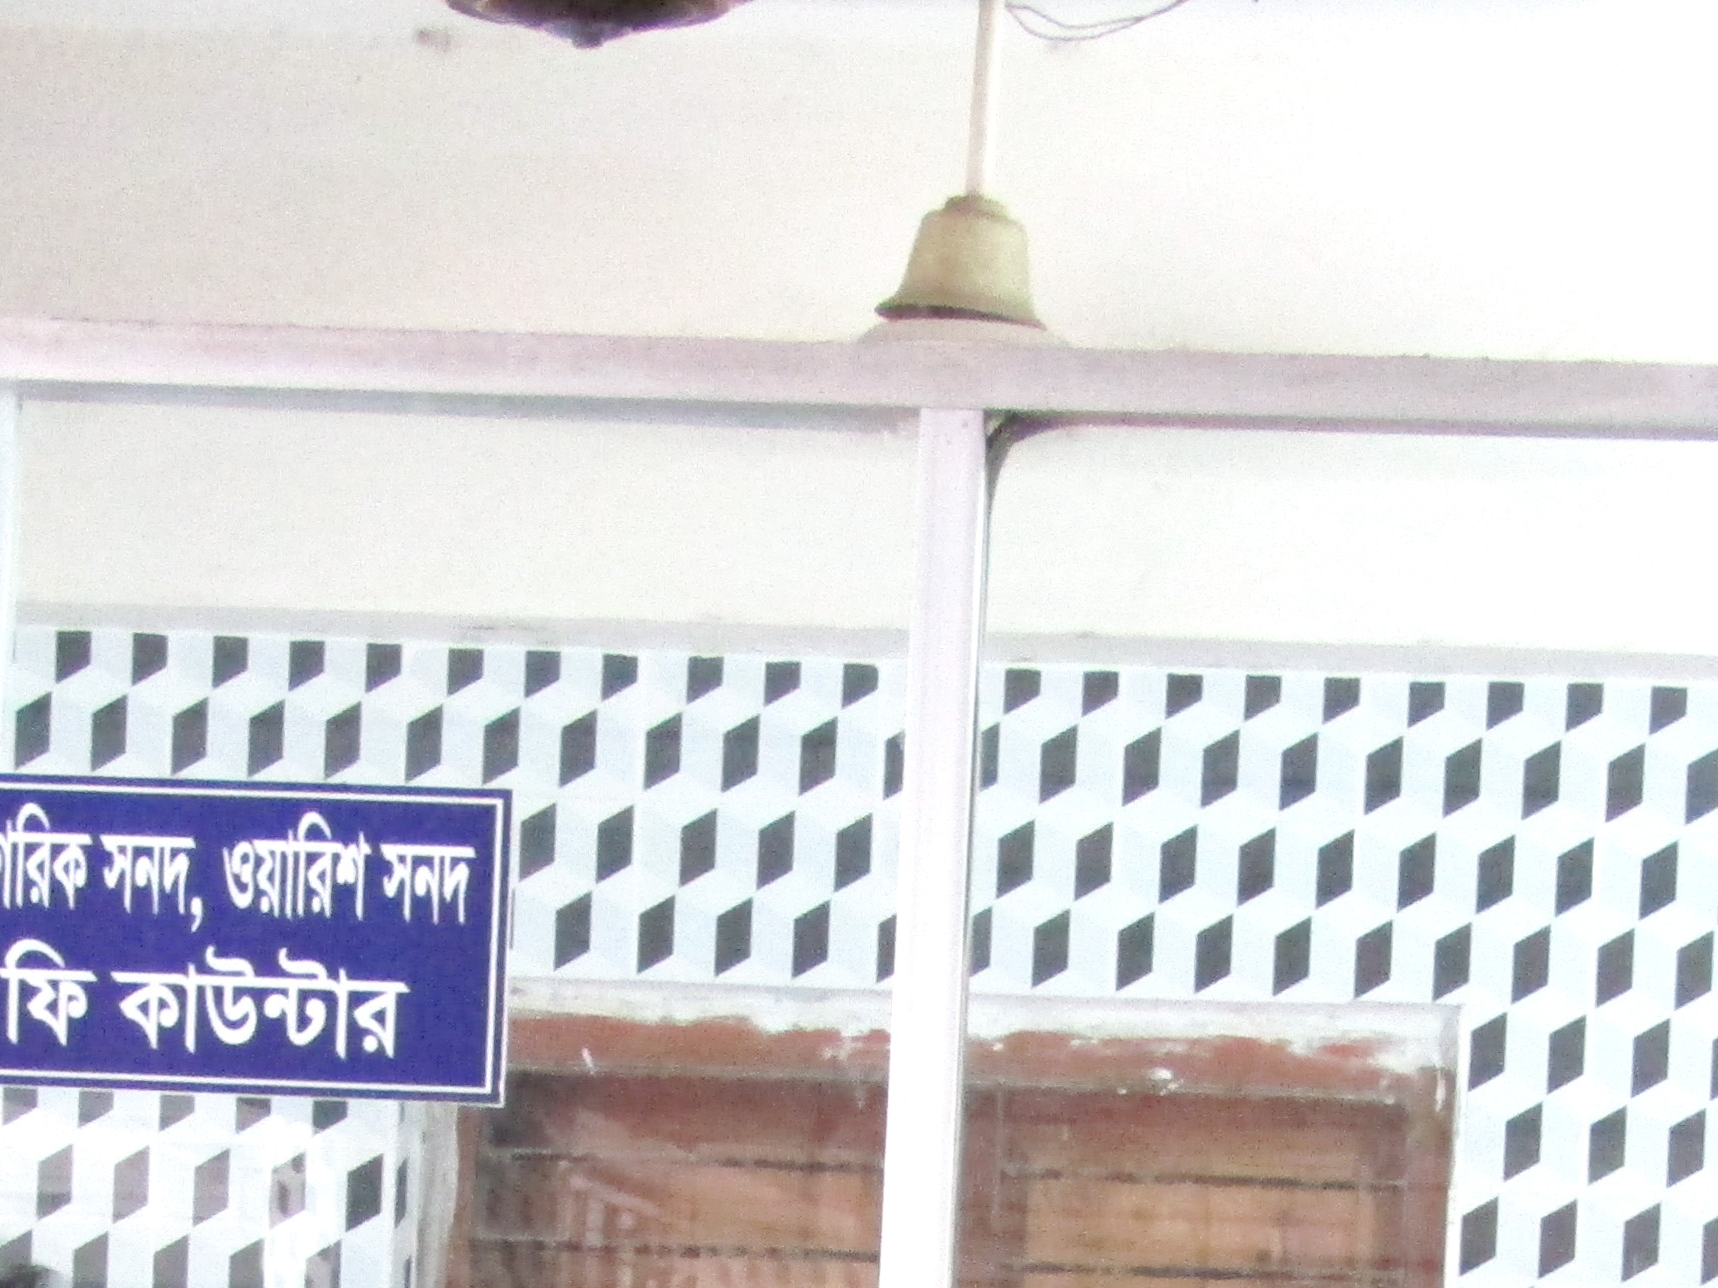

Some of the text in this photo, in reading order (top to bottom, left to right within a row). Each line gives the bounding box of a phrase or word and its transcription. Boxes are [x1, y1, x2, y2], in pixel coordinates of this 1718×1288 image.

[100, 834, 204, 932] সনদ,
[222, 811, 372, 920] ওয়ারিশ
[379, 844, 476, 924] সনদ
[111, 945, 411, 1059] কাউন্টার
